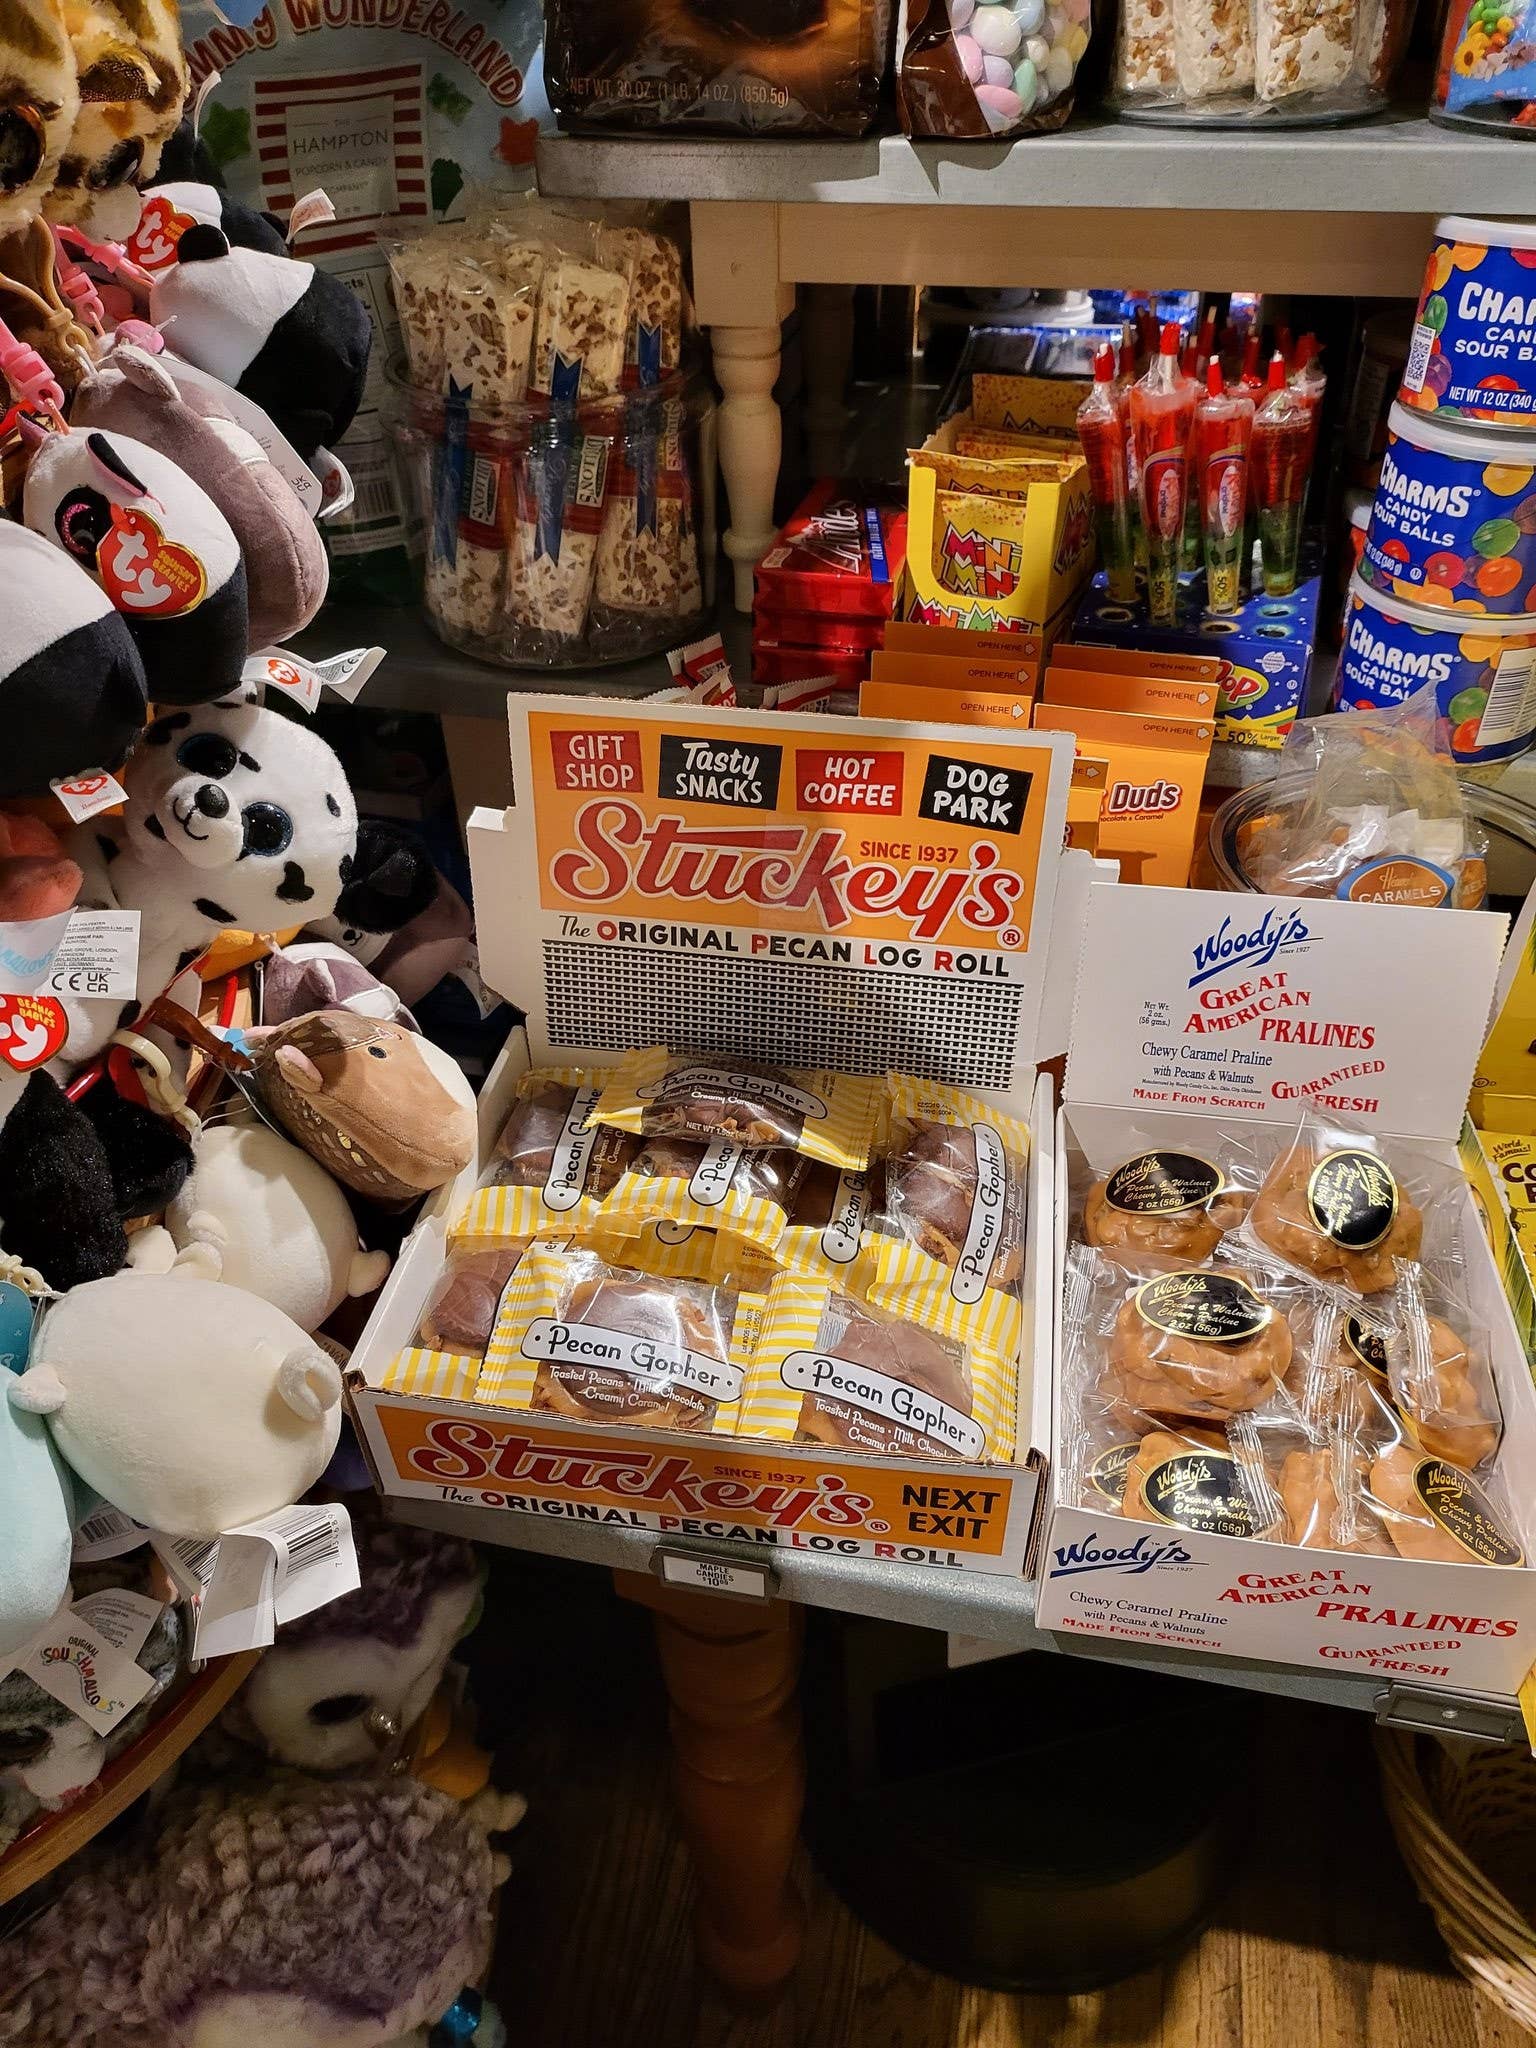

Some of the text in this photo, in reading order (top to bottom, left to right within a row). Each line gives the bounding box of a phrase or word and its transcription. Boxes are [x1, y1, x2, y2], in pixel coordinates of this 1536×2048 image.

[570, 78, 789, 107] NET 30 (850.5g)
[293, 128, 389, 154] HAMPTON
[136, 211, 174, 264] ty
[1455, 339, 1509, 359] SOUR
[1449, 386, 1531, 410] NET WT 12 OZ (340
[1380, 452, 1470, 517] CHARMS
[1374, 501, 1455, 547] SOUR BALLS
[1385, 496, 1431, 525] CANDY
[112, 530, 172, 608] ty
[153, 560, 190, 593] BEANIES
[157, 550, 198, 584] SQUISHY
[1349, 618, 1452, 681] CHARMS
[968, 669, 1015, 680] OPEN HERE
[1346, 662, 1376, 692] SOUR
[1360, 661, 1412, 688] CANDY
[1145, 689, 1196, 700] OPEN HERE
[960, 702, 1010, 715] OPEN HERE
[1143, 724, 1194, 735] OPEN HERE
[1227, 731, 1282, 745] 50% Larger
[569, 734, 624, 760] GIFT
[682, 742, 760, 780] Tasty
[825, 757, 875, 780] HOT
[566, 763, 634, 789] SHOP
[676, 774, 763, 803] SNACKS
[947, 765, 1010, 796] DOG
[803, 782, 896, 806] COFFEE
[1111, 782, 1180, 812] Duds
[933, 791, 1013, 825] PARK
[1100, 813, 1164, 823] hocolate Caramel
[860, 841, 959, 864] SINCE 1937
[551, 797, 1023, 940] Stuckey's
[1358, 885, 1442, 905] CARAMELS
[559, 915, 1009, 977] The ORIGINAL PECAN LOG ROLL
[1191, 906, 1312, 976] Woody's
[87, 972, 109, 983] UK
[1200, 972, 1288, 1010] GREAT
[17, 997, 55, 1018] BEANIE
[19, 1007, 55, 1029] BABIES
[1183, 991, 1311, 1034] AMERICAN
[1138, 1016, 1171, 1028] (56 gms.)
[1259, 1018, 1375, 1049] PRALINES
[1142, 1042, 1273, 1066] Chewy Caramel Praline
[1153, 1066, 1255, 1084] with Pecans & Walnuts
[1271, 1060, 1385, 1099] GUARANTEED
[691, 1091, 725, 1105] Creamy
[728, 1075, 806, 1107] Gopher
[1133, 1088, 1265, 1110] MADE FROM SCRATCH
[1315, 1094, 1378, 1112] FRESH
[686, 1121, 715, 1134] NET WT
[1493, 1139, 1522, 1153] World
[1493, 1144, 1531, 1162] Famous!
[552, 1141, 585, 1189] Pecan
[1172, 1178, 1211, 1187] Walnut
[961, 1144, 1006, 1277] Pecan Gopher
[993, 1246, 1010, 1279] Toasted
[1212, 1303, 1257, 1320] Walnut
[1194, 1322, 1222, 1336] (56g)
[549, 1325, 720, 1387] Pecan Gopher
[550, 1365, 705, 1412] Toasted Pecans Chocolate
[585, 1386, 670, 1413] Creamy Caramel
[813, 1360, 967, 1443] Pecan Gopher
[815, 1398, 915, 1446] Toasted Pecans Milk
[849, 1427, 886, 1451] Creamy
[409, 1420, 873, 1528] Stuckey's
[714, 1466, 806, 1485] SINCE 1937
[1157, 1458, 1216, 1497] Woody's
[902, 1485, 1001, 1514] NEXT
[1173, 1503, 1212, 1518] Chewy
[436, 1485, 963, 1568] The ORIGINAL PECAN LOG ROLL
[908, 1511, 989, 1540] EXIT
[1191, 1519, 1246, 1537] 2 oz (56g)
[1476, 1524, 1510, 1554] Praline
[1051, 1532, 1195, 1576] Woody's
[1454, 1525, 1497, 1560] 2 oz (56g)
[696, 1569, 735, 1583] CANDIES
[699, 1563, 730, 1575] MAPLE
[1238, 1570, 1346, 1589] GREAT
[1217, 1584, 1373, 1604] AMERICAN
[1070, 1591, 1228, 1625] Chewy Caramel Praline
[1315, 1601, 1519, 1637] PRALINES
[1063, 1617, 1222, 1648] MADE FROM SCRATCH
[1084, 1609, 1206, 1635] with Pecans & Walnuts
[68, 1636, 99, 1657] ORIGINAL
[1319, 1639, 1462, 1659] GUARANTEED
[1368, 1658, 1449, 1677] FRESH
